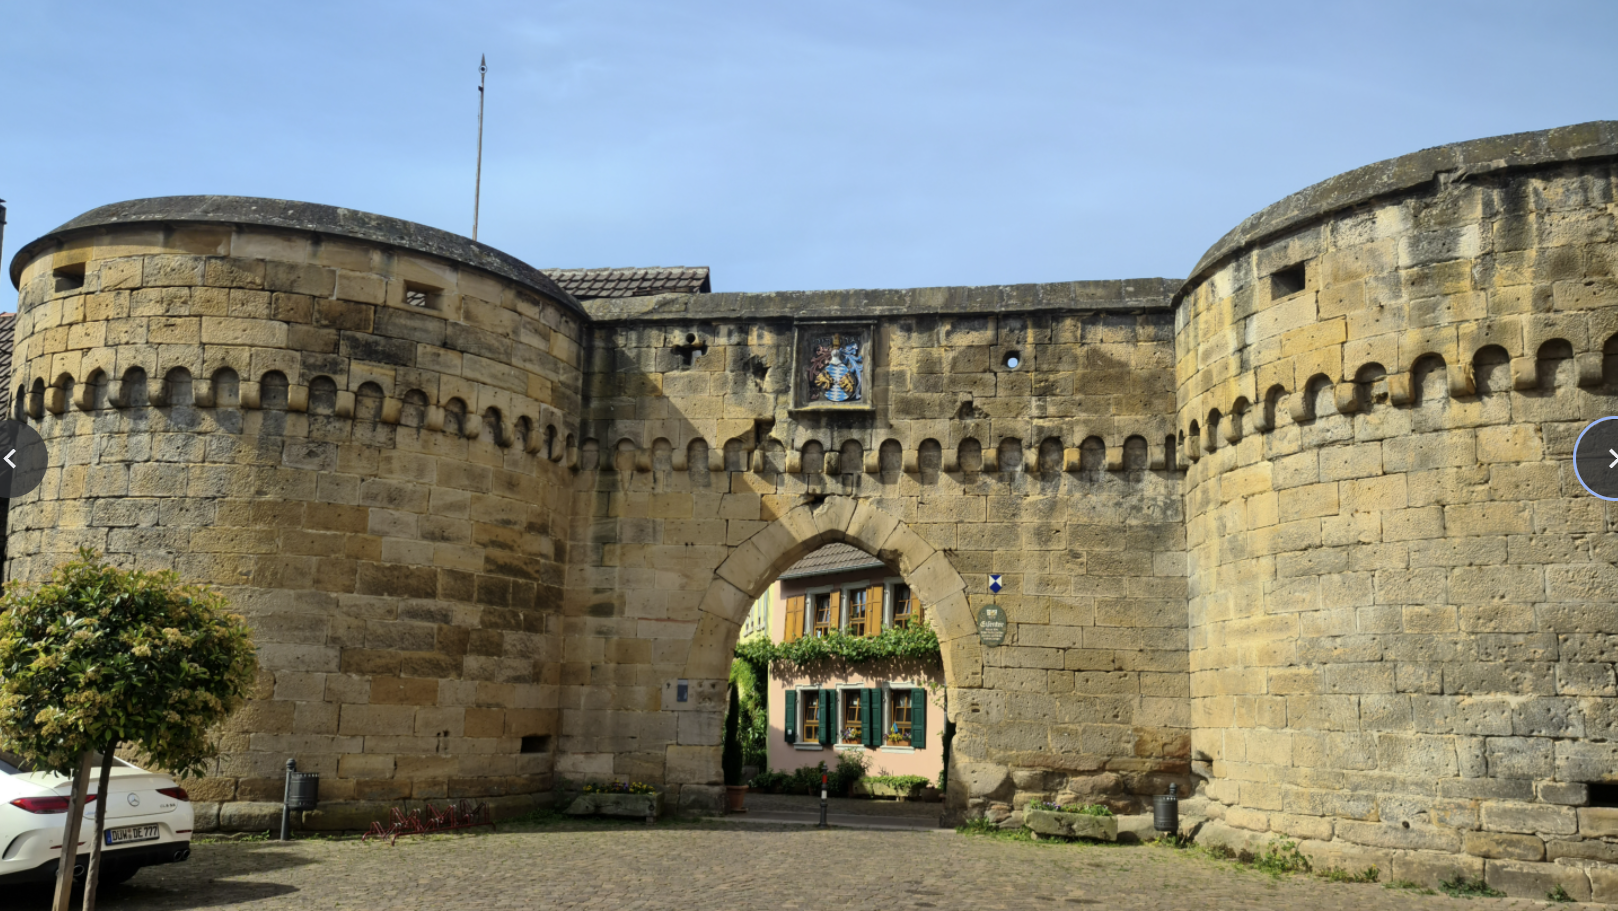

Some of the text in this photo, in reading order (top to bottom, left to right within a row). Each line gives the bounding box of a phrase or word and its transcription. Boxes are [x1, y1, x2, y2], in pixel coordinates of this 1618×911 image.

[112, 825, 158, 841] DÜW DE 777
